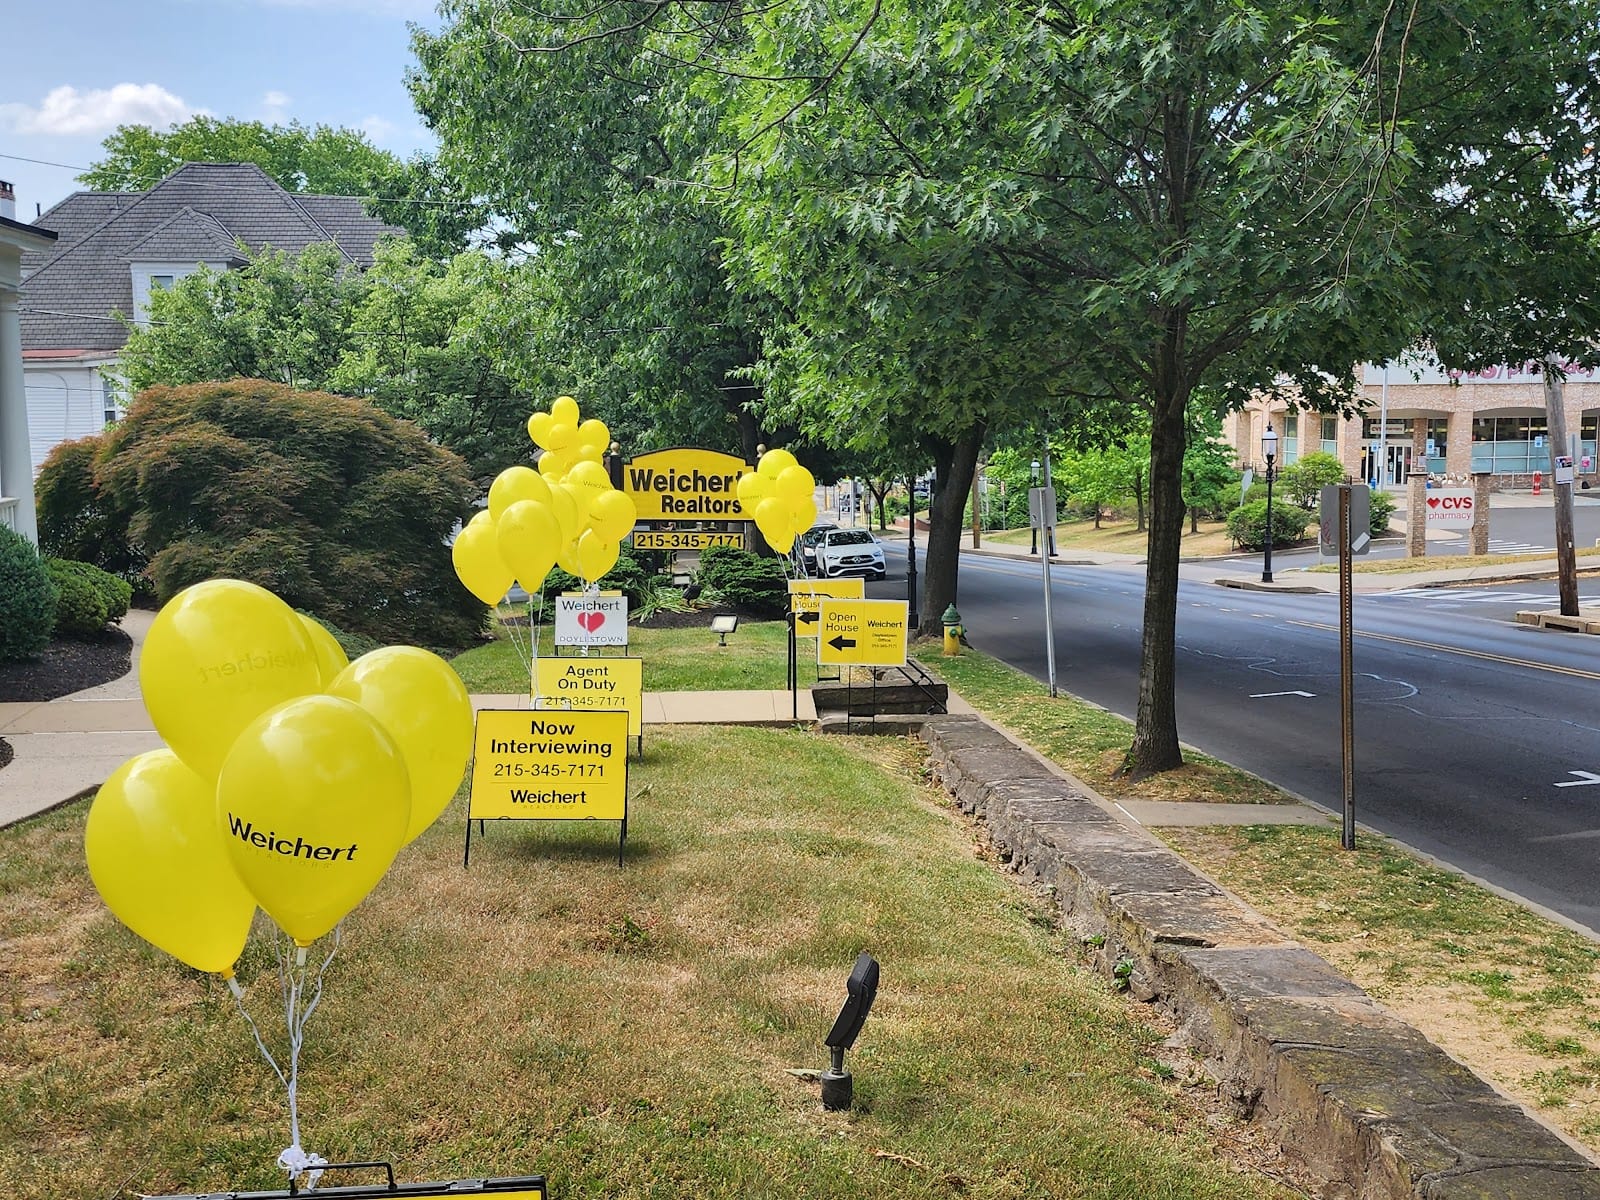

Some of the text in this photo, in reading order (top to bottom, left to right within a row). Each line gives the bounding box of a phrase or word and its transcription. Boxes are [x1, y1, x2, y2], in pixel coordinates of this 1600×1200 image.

[661, 494, 742, 514] Realtors
[1442, 496, 1473, 510] CVS
[1428, 511, 1472, 521] pharmacy
[637, 534, 742, 548] 215-345-7171
[562, 600, 620, 611] Weichert
[828, 612, 857, 623] Open
[867, 619, 903, 628] Weichert
[826, 622, 859, 632] House
[565, 665, 609, 678] Agent
[557, 678, 617, 692] On Duty
[530, 720, 575, 735] Now
[491, 739, 613, 758] Interviewing
[494, 764, 605, 777] 215-345-7171
[510, 789, 587, 804] Weichert
[228, 812, 358, 861] Weichert
